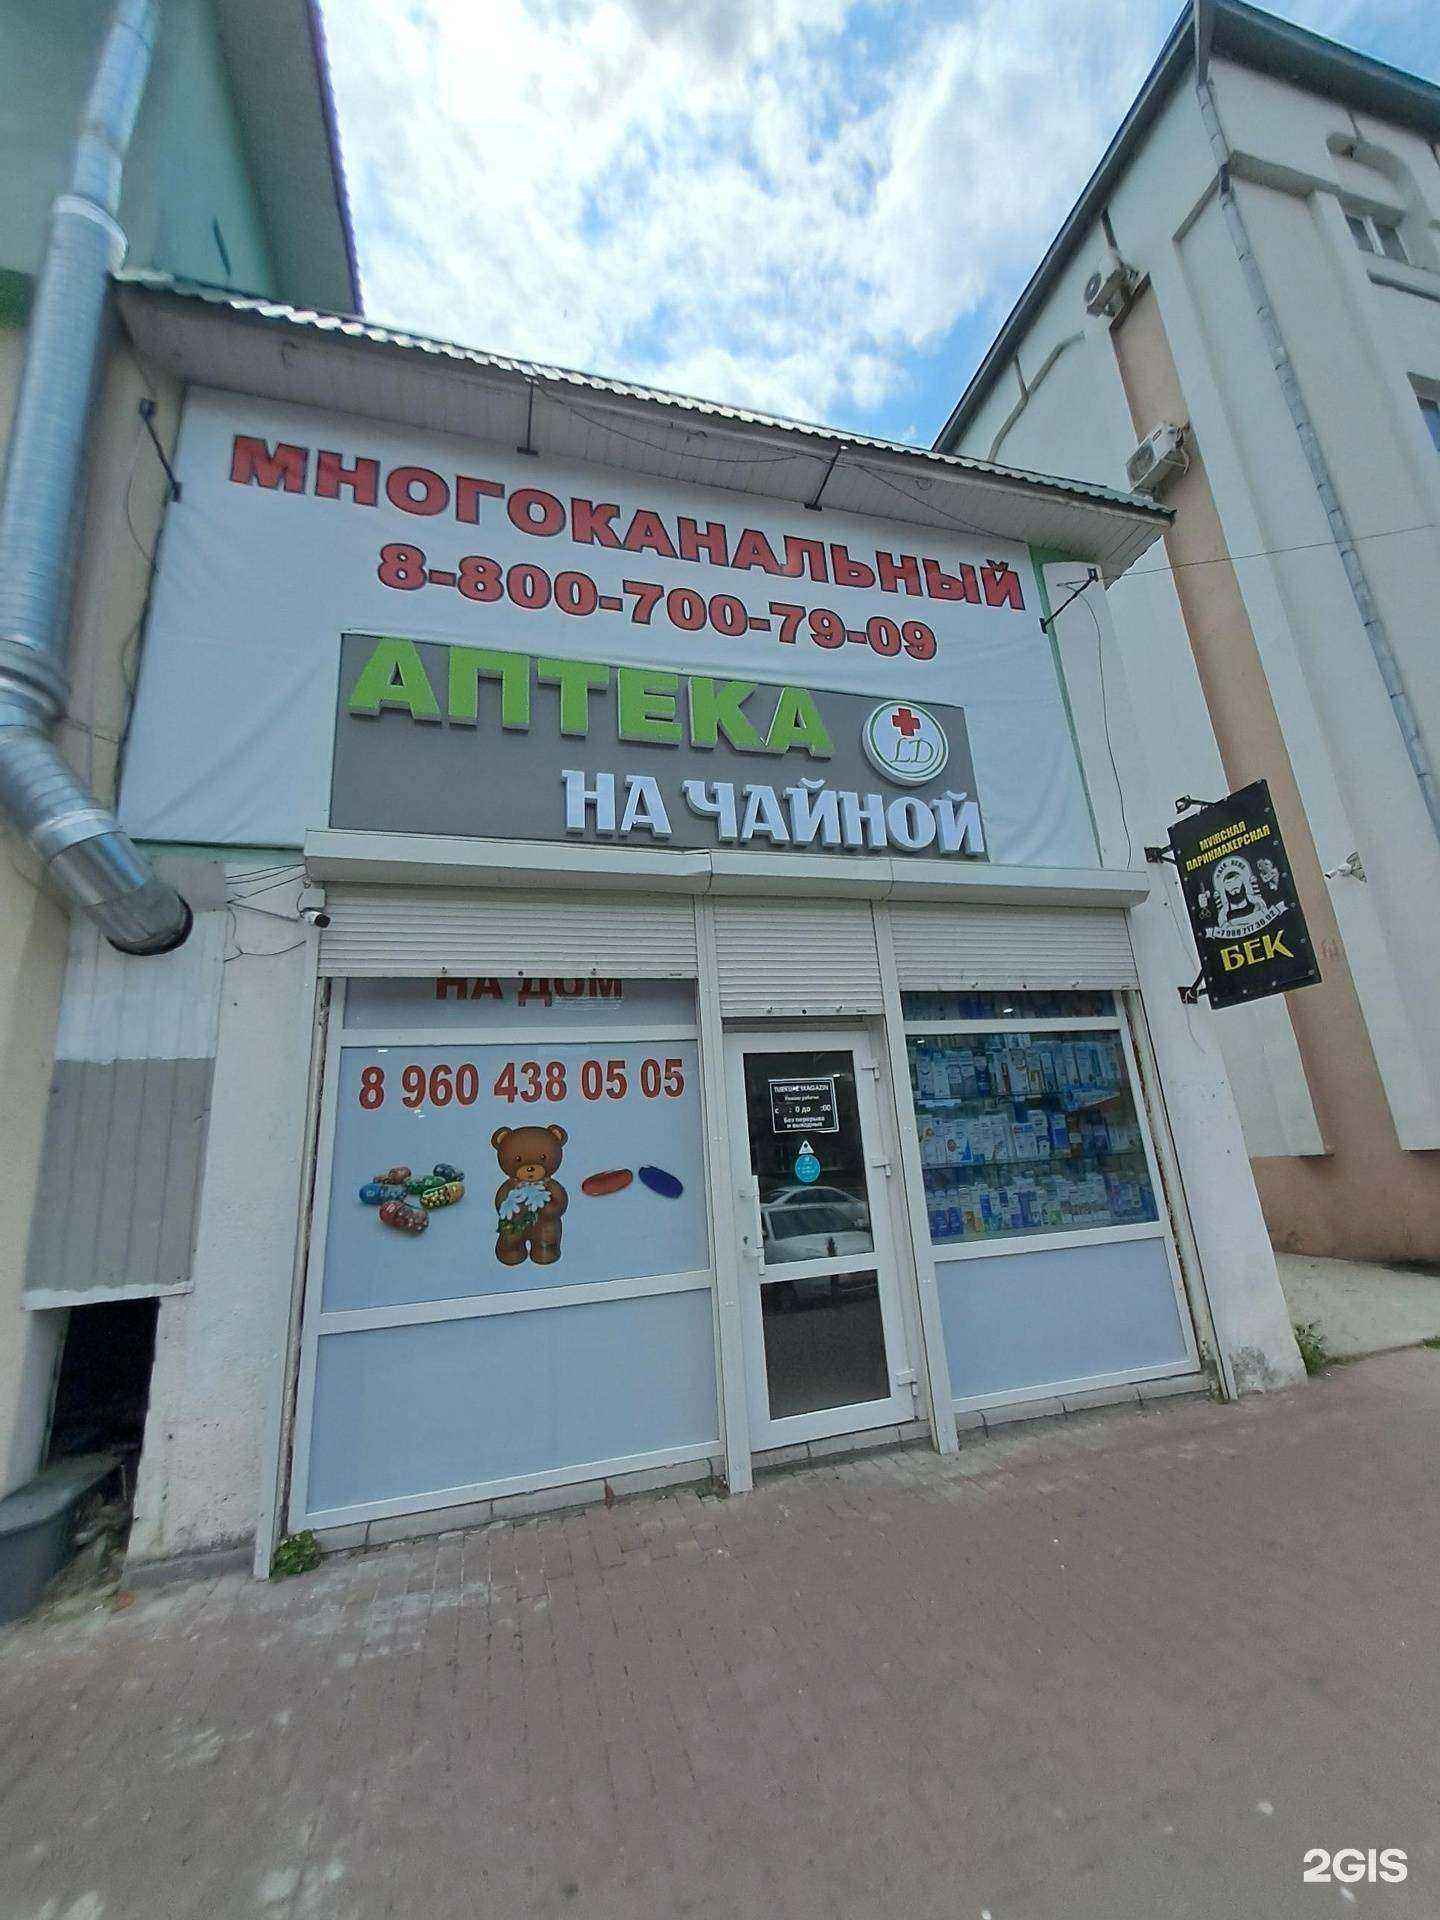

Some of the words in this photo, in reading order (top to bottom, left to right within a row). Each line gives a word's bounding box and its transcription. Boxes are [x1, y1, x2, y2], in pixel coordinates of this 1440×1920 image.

[230, 434, 1026, 611] МНОГОКАНАЛЬНЫЙ
[378, 543, 937, 661] 8-800-700-79-09
[348, 636, 835, 759] АПТЕКА
[561, 769, 673, 840] НА
[682, 777, 986, 857] ЧАЙНОЙ
[1220, 930, 1295, 971] БЕК
[359, 1066, 385, 1110] 8
[401, 1063, 480, 1109] 960
[493, 1060, 567, 1104] 438
[581, 1059, 628, 1101] 05
[640, 1058, 685, 1099] 05
